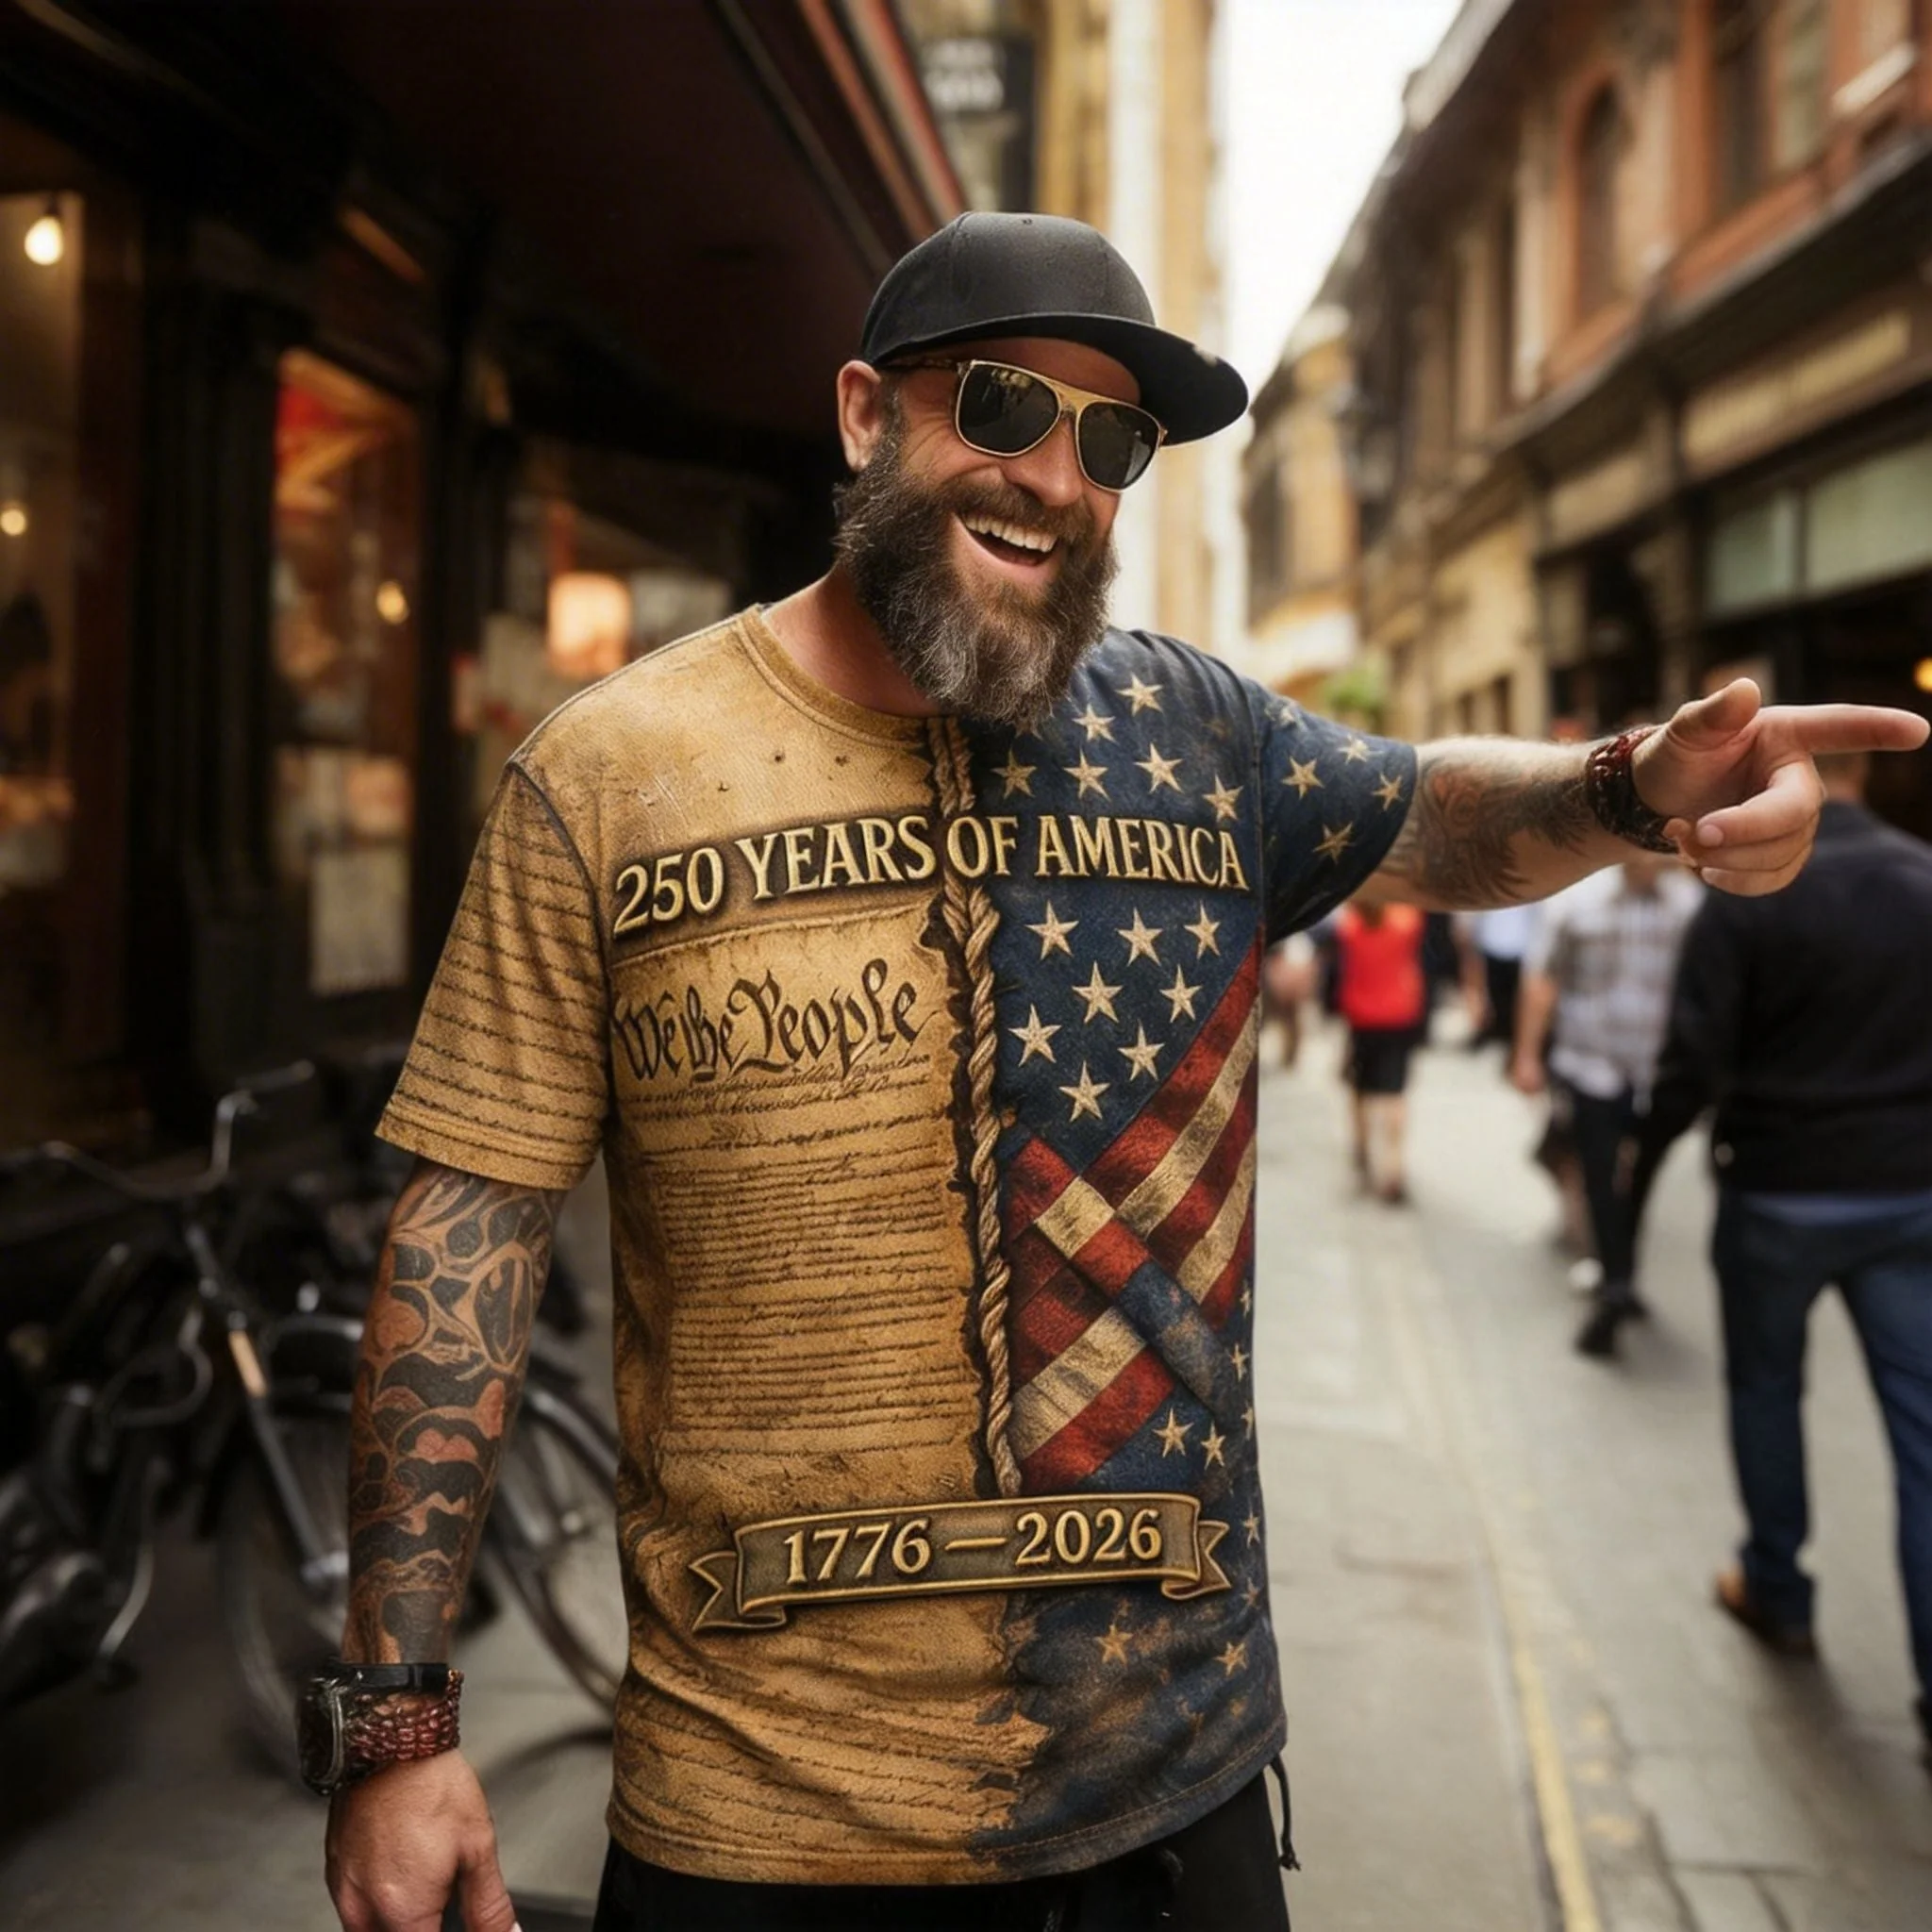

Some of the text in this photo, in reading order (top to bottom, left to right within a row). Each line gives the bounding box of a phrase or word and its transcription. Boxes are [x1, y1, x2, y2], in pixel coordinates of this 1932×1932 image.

[613, 814, 1250, 934] 250 YEARS OF AMERICA
[609, 991, 684, 1081] We
[727, 958, 934, 1080] People
